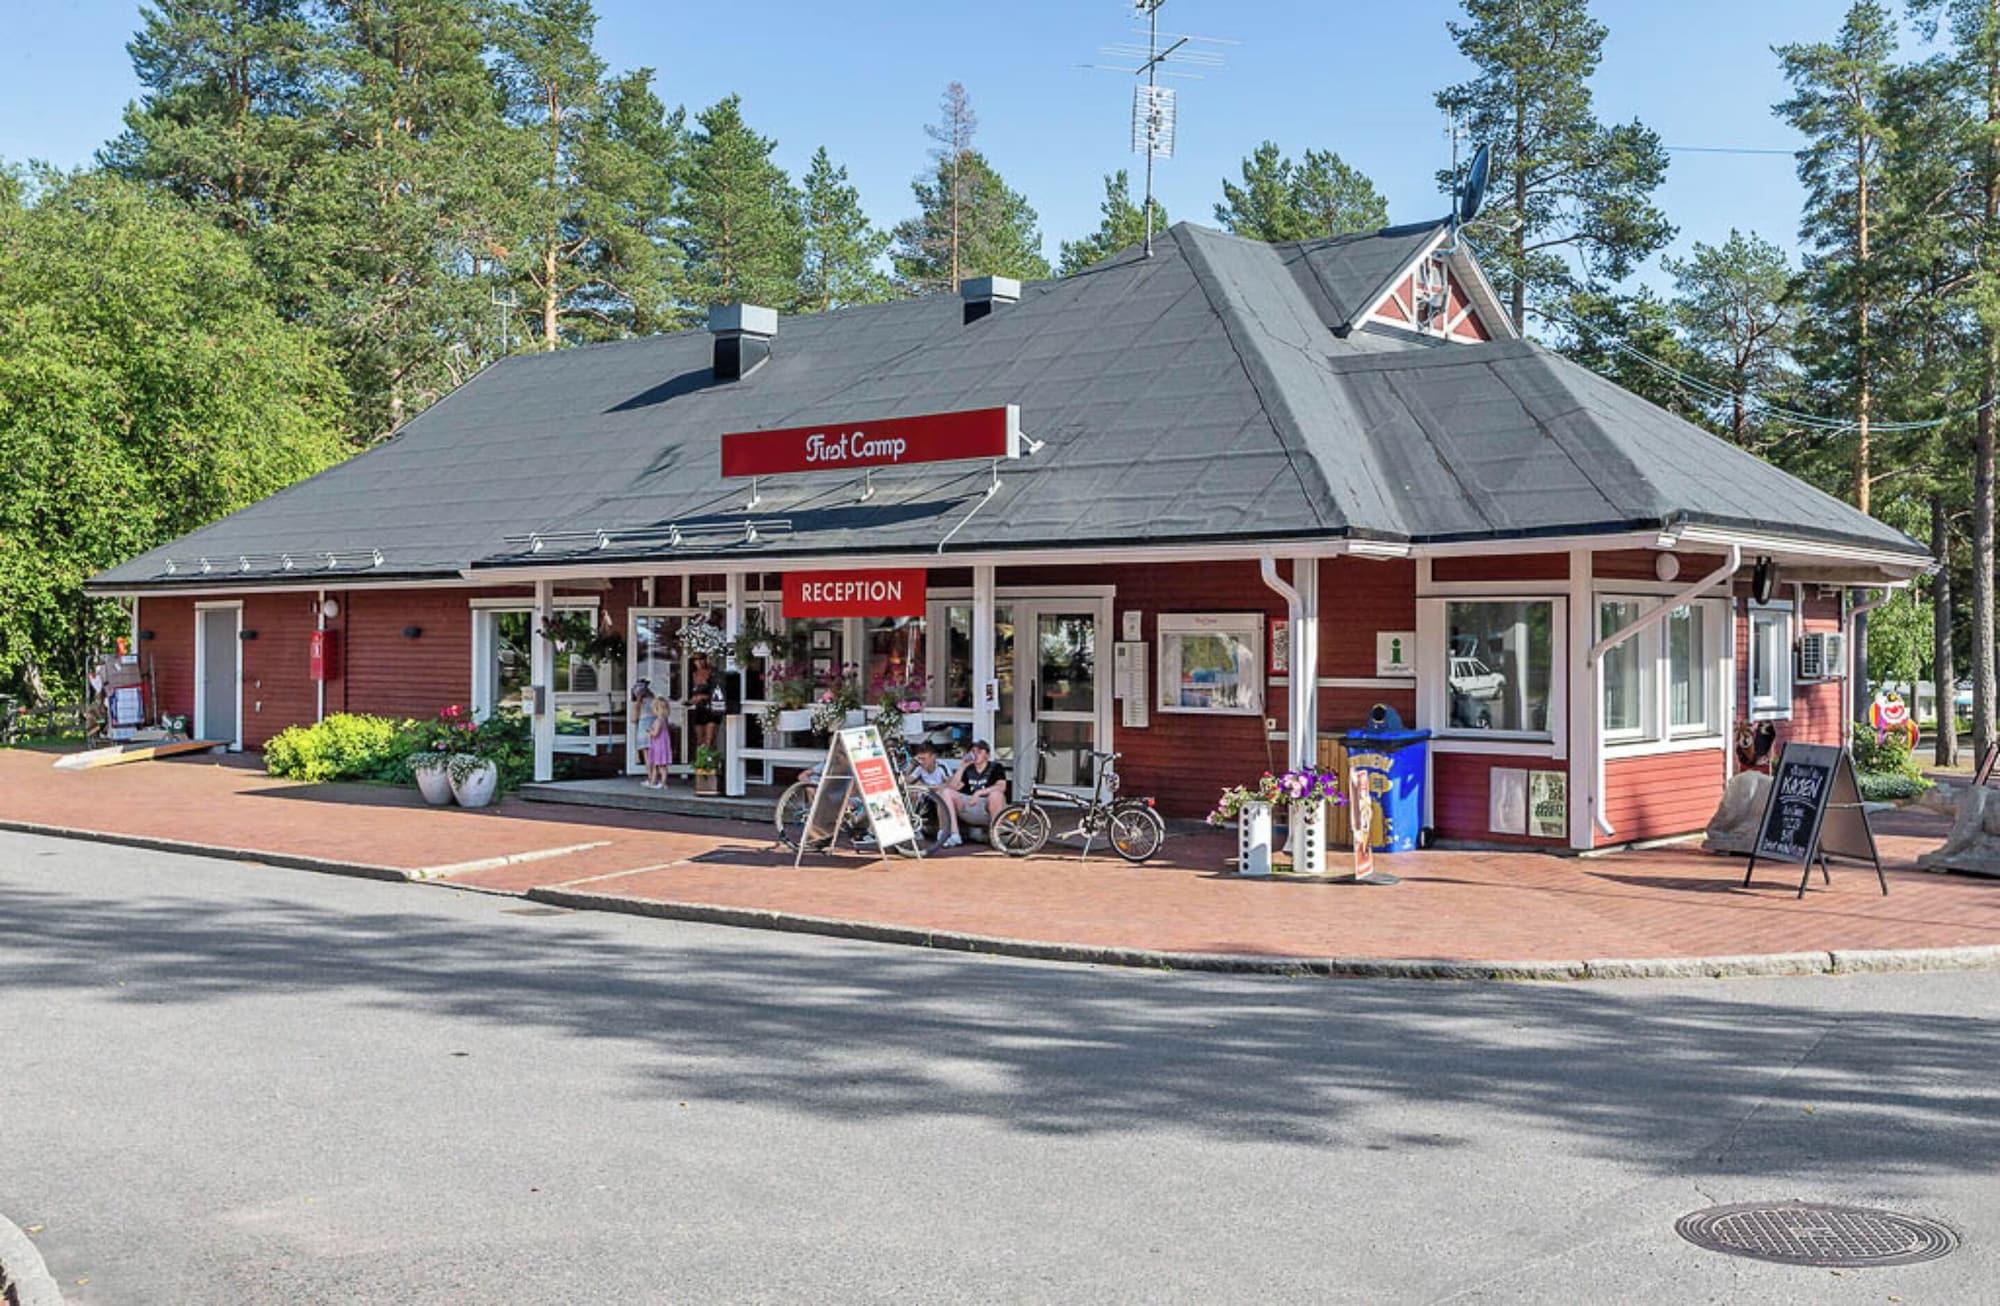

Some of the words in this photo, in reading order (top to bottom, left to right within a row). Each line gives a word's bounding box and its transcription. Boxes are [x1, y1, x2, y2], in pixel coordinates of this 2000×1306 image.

[806, 433, 848, 461] First
[851, 432, 906, 462] Camp
[802, 581, 902, 602] RECEPTION
